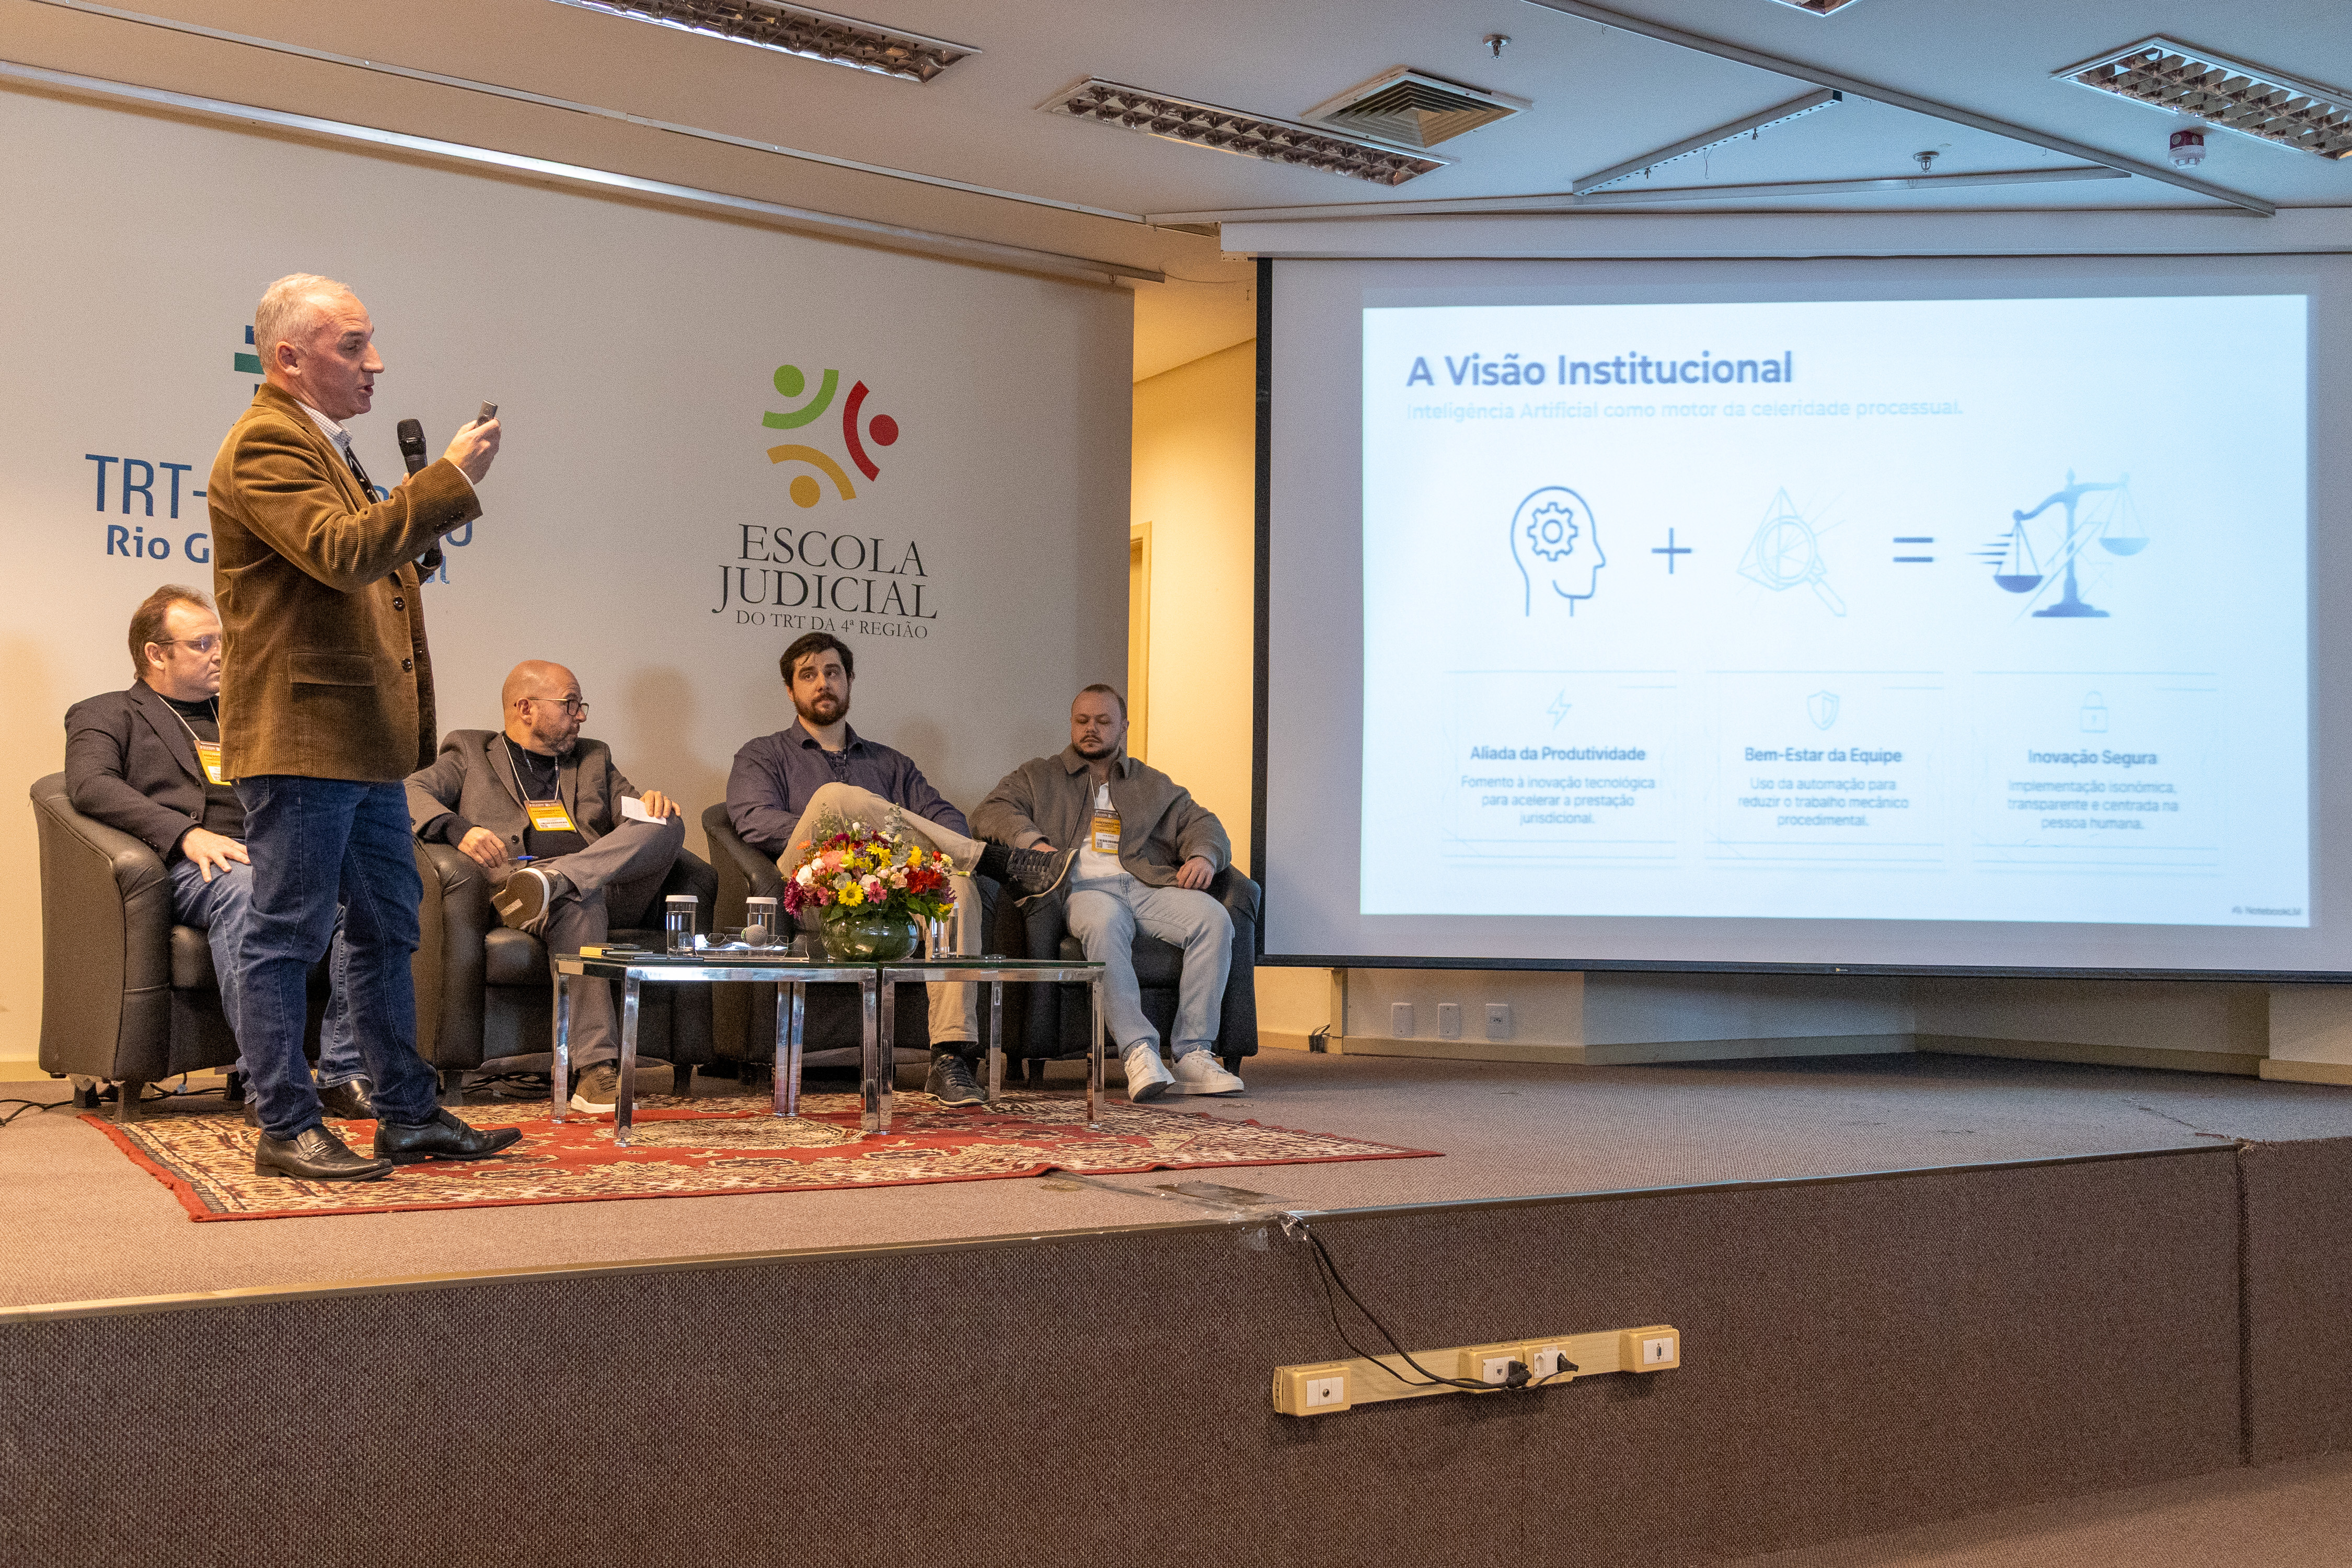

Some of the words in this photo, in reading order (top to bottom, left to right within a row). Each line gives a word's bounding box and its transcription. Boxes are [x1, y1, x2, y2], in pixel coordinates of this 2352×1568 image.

[1406, 356, 1436, 387] A
[1445, 353, 1546, 386] Visão
[1559, 350, 1793, 385] Institucional
[1408, 402, 1516, 422] Inteligência
[1520, 401, 1599, 419] Artificial
[1604, 403, 1657, 418] como
[1662, 401, 1717, 417] motor
[1724, 401, 1746, 417] da
[1752, 400, 1850, 417] celeridade
[1857, 399, 1964, 419] processual.
[107, 524, 170, 559] Rio
[737, 523, 928, 577] ESCOLA
[711, 565, 938, 618] JUDICIAL
[736, 609, 765, 625] DO
[770, 613, 805, 629] TRT
[811, 616, 836, 631] DA
[841, 618, 854, 632] 4ª
[860, 620, 927, 639] REGIÃO
[1471, 746, 1517, 760] Aliada
[1520, 746, 1539, 760] da
[1542, 746, 1647, 761] Produtividade
[1745, 747, 1824, 762] Bem-Estar
[1828, 747, 1847, 762] da
[1850, 747, 1903, 765] Equipe
[2028, 749, 2099, 766] Inovação
[2102, 750, 2158, 768] Segura
[1461, 776, 1514, 788] Fomento
[1528, 776, 1582, 791] inovação
[1585, 776, 1656, 791] tecnológica
[1750, 778, 1775, 789] Uso
[1778, 777, 1794, 790] da
[1797, 777, 1865, 792] automação
[1869, 780, 1897, 792] para
[1482, 795, 1509, 808] para
[1512, 794, 1561, 806] acelerar
[1564, 795, 1572, 806] a
[1574, 794, 1635, 809] prestação
[1738, 796, 1781, 808] reduzir
[1784, 798, 1792, 808] o
[1795, 796, 1847, 808] trabalho
[1849, 796, 1910, 809] mecânico
[2008, 799, 2089, 812] transparente
[2092, 801, 2100, 811] e
[2103, 799, 2160, 812] centrada
[2163, 801, 2180, 812] na
[2042, 818, 2087, 831] pessoa
